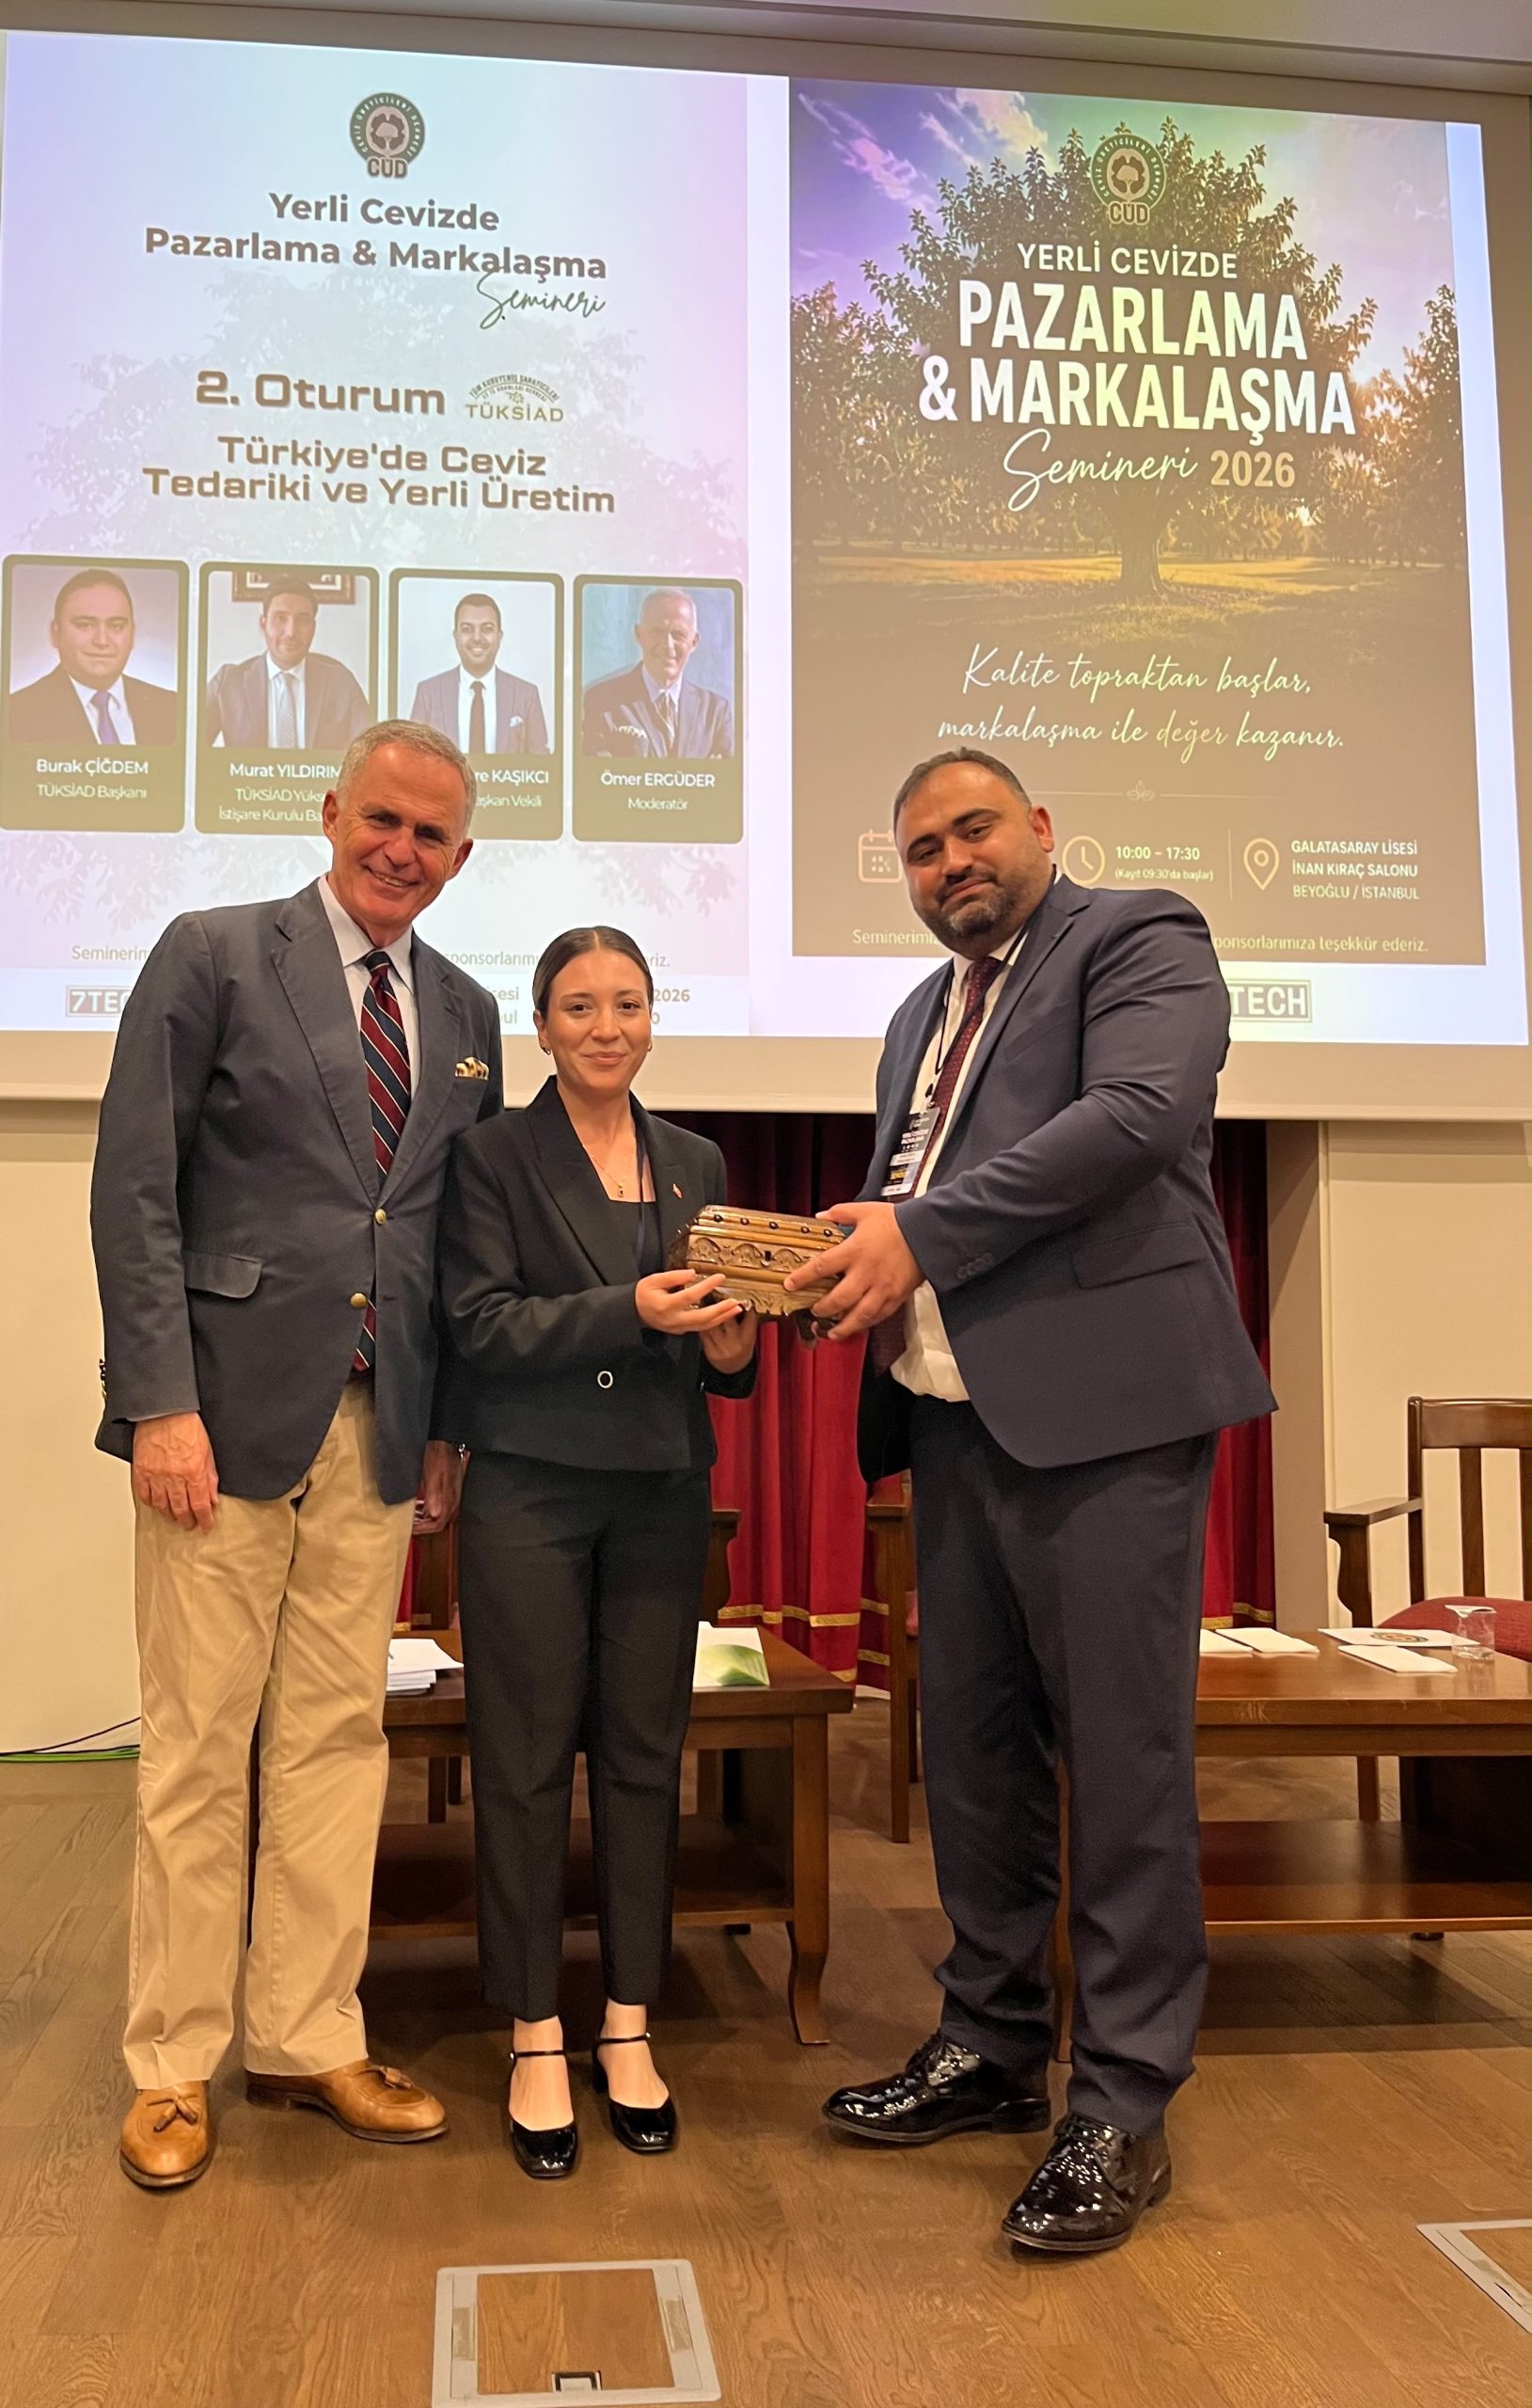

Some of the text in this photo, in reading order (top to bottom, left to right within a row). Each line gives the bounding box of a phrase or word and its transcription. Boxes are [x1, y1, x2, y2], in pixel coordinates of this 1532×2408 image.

[268, 192, 499, 231] Yerli Cevizde
[145, 227, 607, 283] Pazarlama & Markalaşma
[1017, 240, 1238, 278] YERLİ CEVİZDE
[477, 266, 607, 330] Semineri
[959, 279, 1308, 360] PAZARLAMA
[196, 370, 446, 415] 2. Oturum
[919, 355, 1356, 446] & MARKALAŞMA
[466, 402, 564, 421] TÜKSİAD
[217, 436, 546, 477] Türkiye'de Ceviz
[1003, 428, 1295, 512] Semineri 2026
[142, 467, 615, 513] Tedariki ve Yerli Üretim
[962, 643, 1311, 704] Kalite topraktan başlar,
[938, 705, 1343, 764] markalaşma ile değer kazanır.
[37, 756, 149, 778] Burak ÇİĞDEM
[229, 763, 275, 777] Murat
[475, 771, 489, 783] re
[601, 769, 715, 787] Ömer ERGÜDER
[37, 783, 147, 801] TÜKSİAD Başkanı
[235, 786, 324, 802] TÜKSİAD Yüks
[476, 794, 543, 809] aşkan Vekili
[628, 797, 688, 811] Moderatör
[263, 809, 304, 821] Kurulu
[306, 809, 323, 821] Ba
[1115, 846, 1151, 860] 10:00
[1166, 847, 1200, 861] 17:30
[1291, 839, 1418, 855] GALATASARAY LİSESİ
[1292, 860, 1418, 879] İNAN KIRAÇ SALONU
[1293, 882, 1419, 900] BEYOĞLU / İSTANBUL
[71, 945, 150, 960] Seminerim
[1213, 935, 1429, 953] ponsorlarımıza teşekkür ederiz.
[1228, 986, 1306, 1016] TECH
